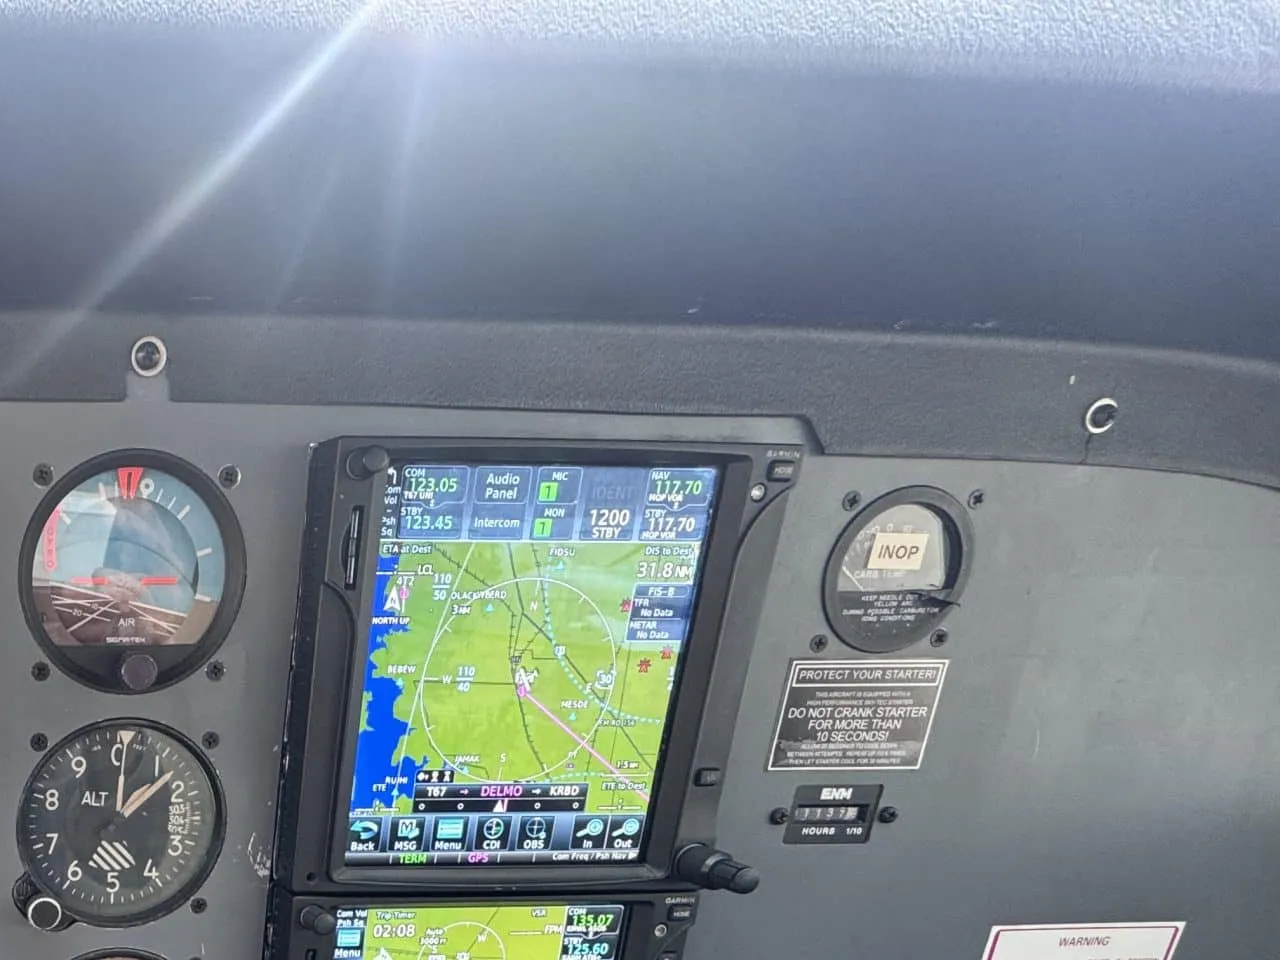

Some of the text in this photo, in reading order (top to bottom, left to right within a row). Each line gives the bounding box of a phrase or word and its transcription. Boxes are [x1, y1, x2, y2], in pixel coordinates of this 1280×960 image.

[405, 467, 426, 478] COM
[552, 471, 569, 482] MIC
[407, 478, 457, 493] 123.05
[486, 473, 520, 486] Audio
[485, 487, 517, 500] Panel
[654, 481, 702, 495] 117.70
[544, 508, 565, 518] MON
[589, 509, 630, 527] 1200
[405, 516, 452, 530] 123.45
[474, 517, 520, 529] Intercom
[647, 518, 695, 532] 117.70
[592, 527, 621, 540] STBY
[878, 545, 919, 559] INOP
[118, 617, 135, 627] AIR
[799, 669, 937, 681] PROTECT YOUR STARTER!
[788, 706, 928, 719] DO NOT CRANK STARTER
[808, 719, 902, 731] FOR MORE THAN
[816, 730, 889, 743] 10 SECONDS!
[71, 756, 87, 778] 9
[171, 780, 184, 802] 2
[480, 785, 523, 797] DELMO
[820, 788, 852, 800] ENM
[45, 789, 59, 811] 8
[81, 791, 109, 807] ALT
[801, 827, 836, 836] HOURS
[46, 833, 59, 855] 7
[168, 835, 183, 856] 3
[350, 841, 375, 852] Back
[394, 840, 417, 851] MSG
[434, 839, 462, 851] Menu
[483, 839, 501, 850] CDI
[523, 838, 545, 850] OBS
[614, 837, 633, 849] Out
[467, 852, 489, 863] GPS
[67, 860, 82, 881] 6
[143, 859, 159, 880] 4
[106, 872, 120, 893] 5
[572, 915, 613, 928] 135.07
[372, 923, 417, 938] 02:08
[1059, 936, 1111, 947] WARNING
[334, 948, 361, 960] Menu
[567, 943, 609, 955] 125.60
